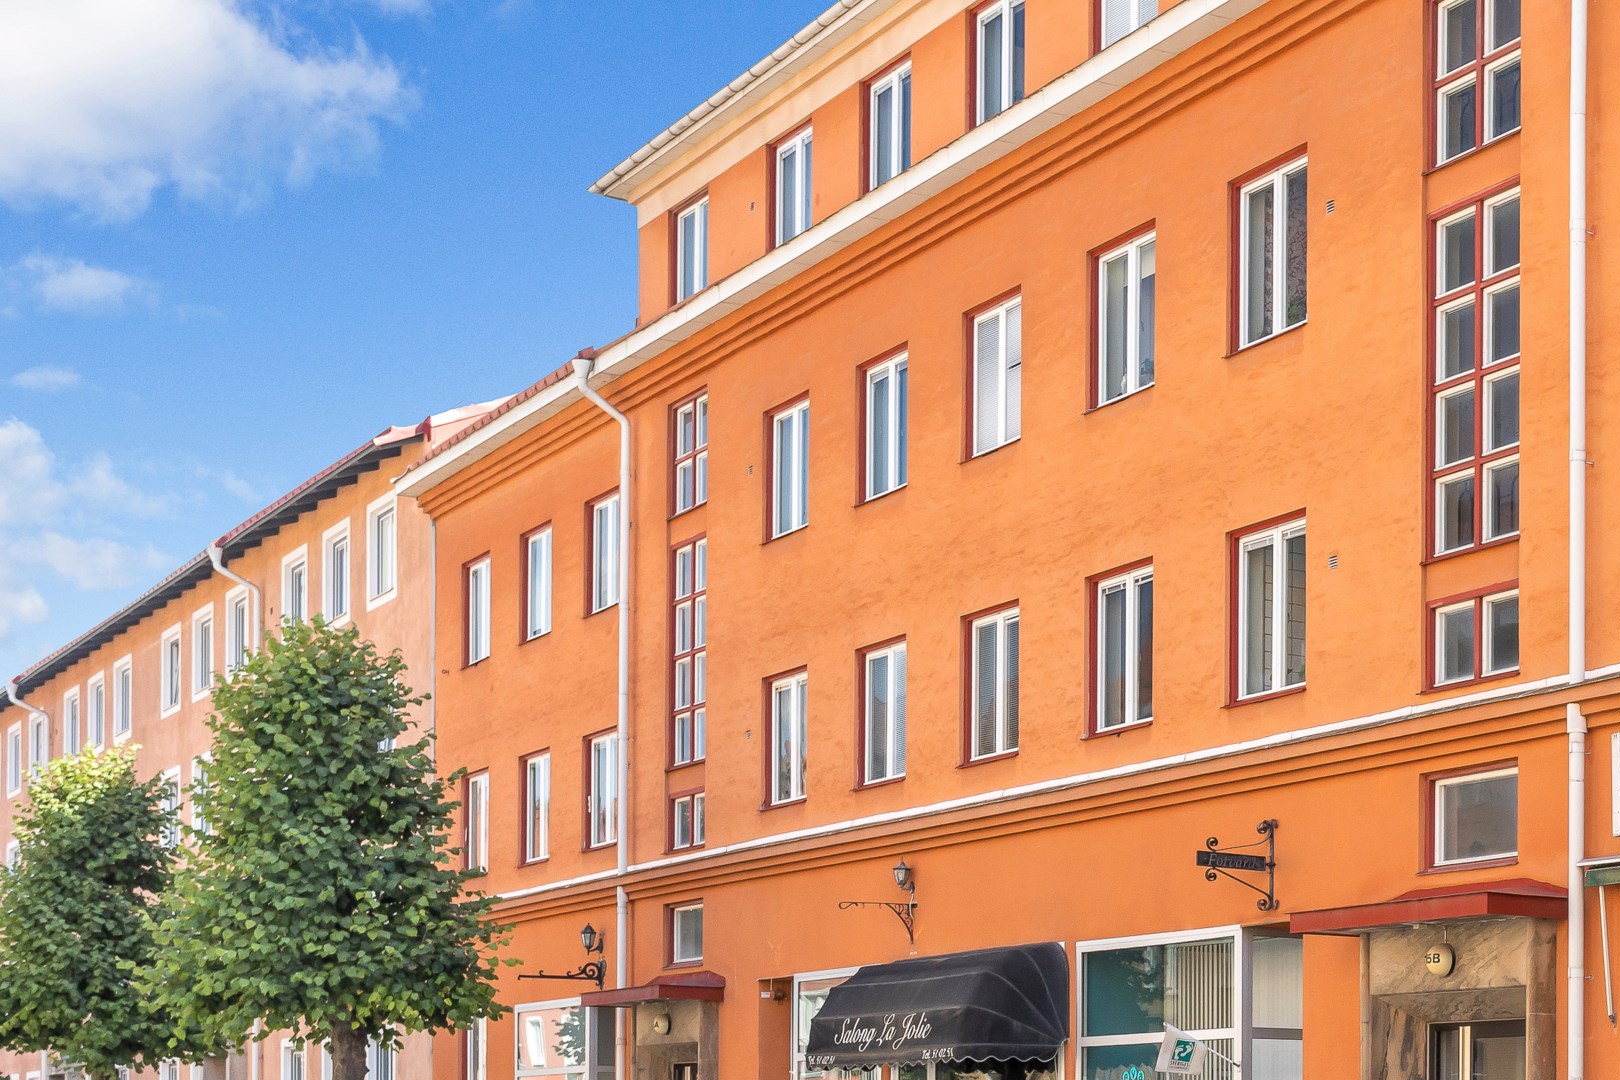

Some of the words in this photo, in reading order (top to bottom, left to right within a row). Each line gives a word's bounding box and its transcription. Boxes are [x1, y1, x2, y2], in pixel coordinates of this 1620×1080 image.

[833, 1017, 878, 1053] Salong
[875, 1013, 897, 1047] La
[892, 1011, 933, 1050] Jolie
